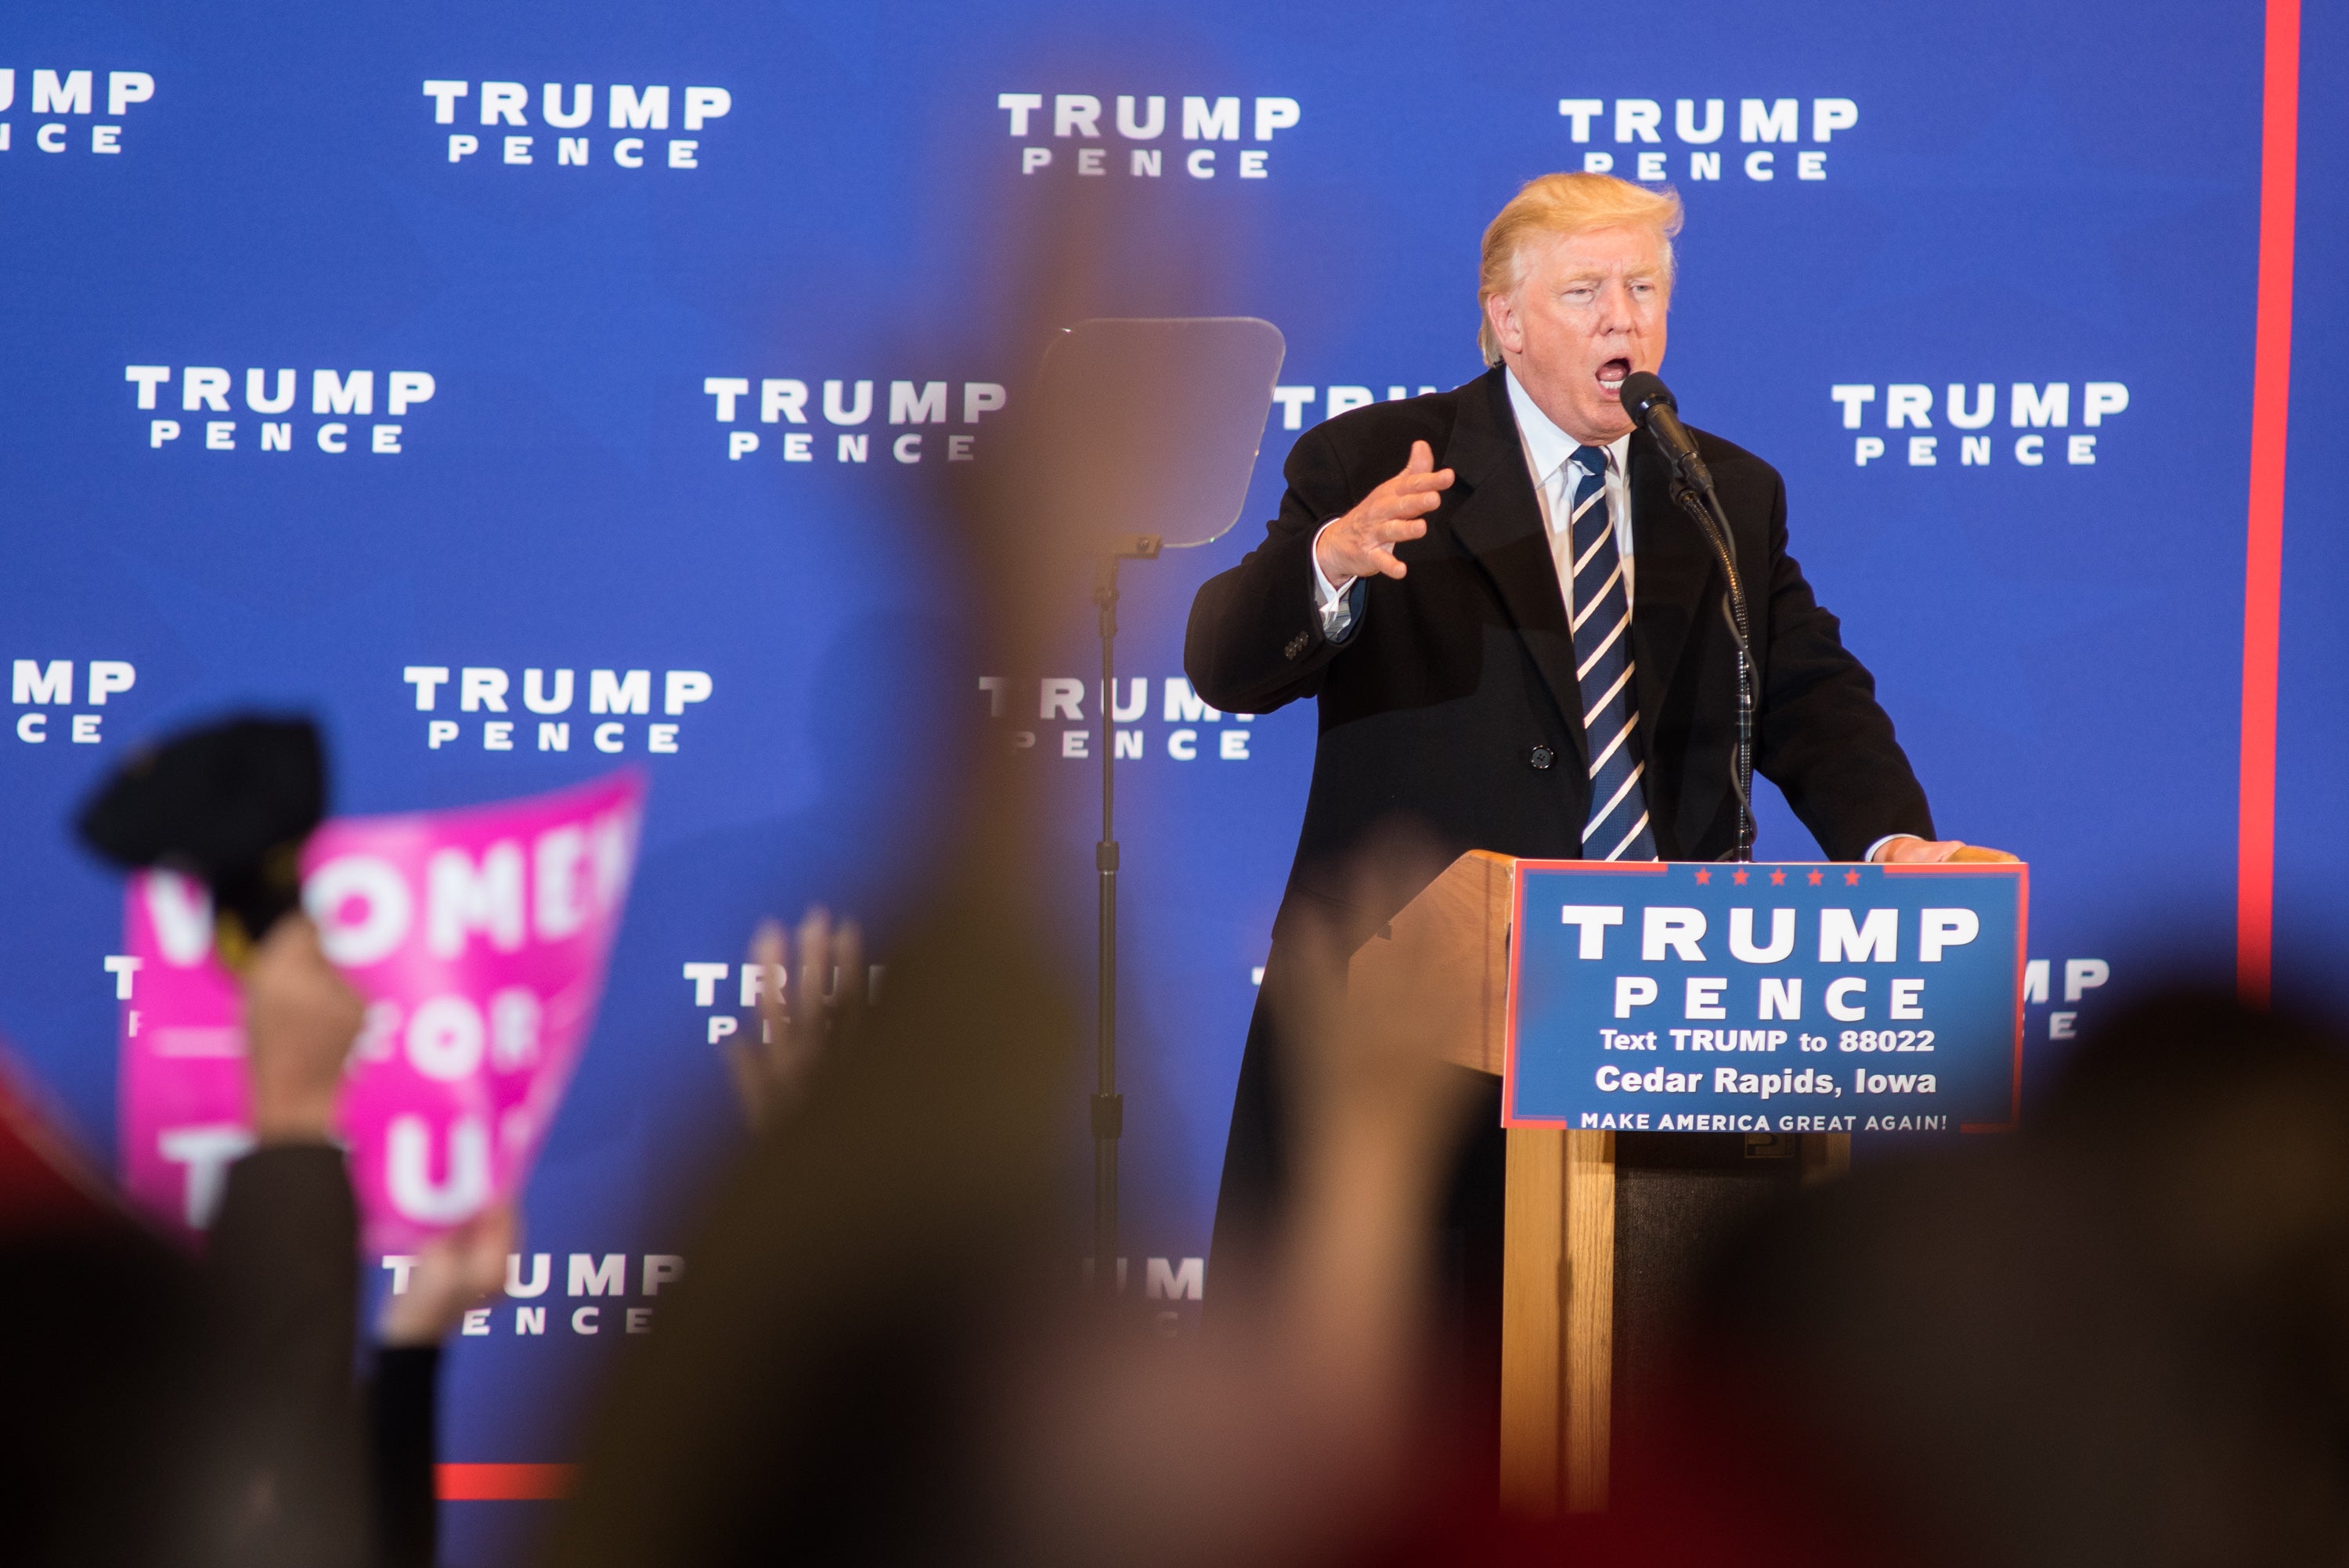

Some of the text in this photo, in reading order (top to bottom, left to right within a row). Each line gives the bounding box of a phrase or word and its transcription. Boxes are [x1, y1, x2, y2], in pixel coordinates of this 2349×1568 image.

[423, 80, 732, 131] TRUMP
[998, 92, 1301, 141] TRUMP
[1557, 98, 1859, 145] TRUMP
[448, 135, 699, 169] PENCE
[1022, 147, 1269, 179] PENCE
[1583, 150, 1828, 182] PENCE
[125, 366, 436, 416] TRUMP
[704, 377, 1007, 425] TRUMP
[1831, 381, 2131, 430] TRUMP
[150, 420, 403, 454] PENCE
[728, 431, 976, 463] PENCE
[1854, 434, 2097, 467] PENCE
[403, 666, 713, 716] TRUMP
[979, 676, 1255, 723] TRUM
[428, 720, 680, 754] PENCE
[1561, 904, 1980, 964] TRUMP
[1613, 975, 1925, 1022] PENCE
[1599, 1028, 1936, 1053] Text TRUMP to 88022
[1594, 1065, 1937, 1101] Cedar Rapids, Iowa
[1580, 1112, 1947, 1132] MAKE AMERICA GREAT AGAIN!
[381, 1253, 687, 1298] TUMP
[461, 1307, 654, 1336] ENCE
